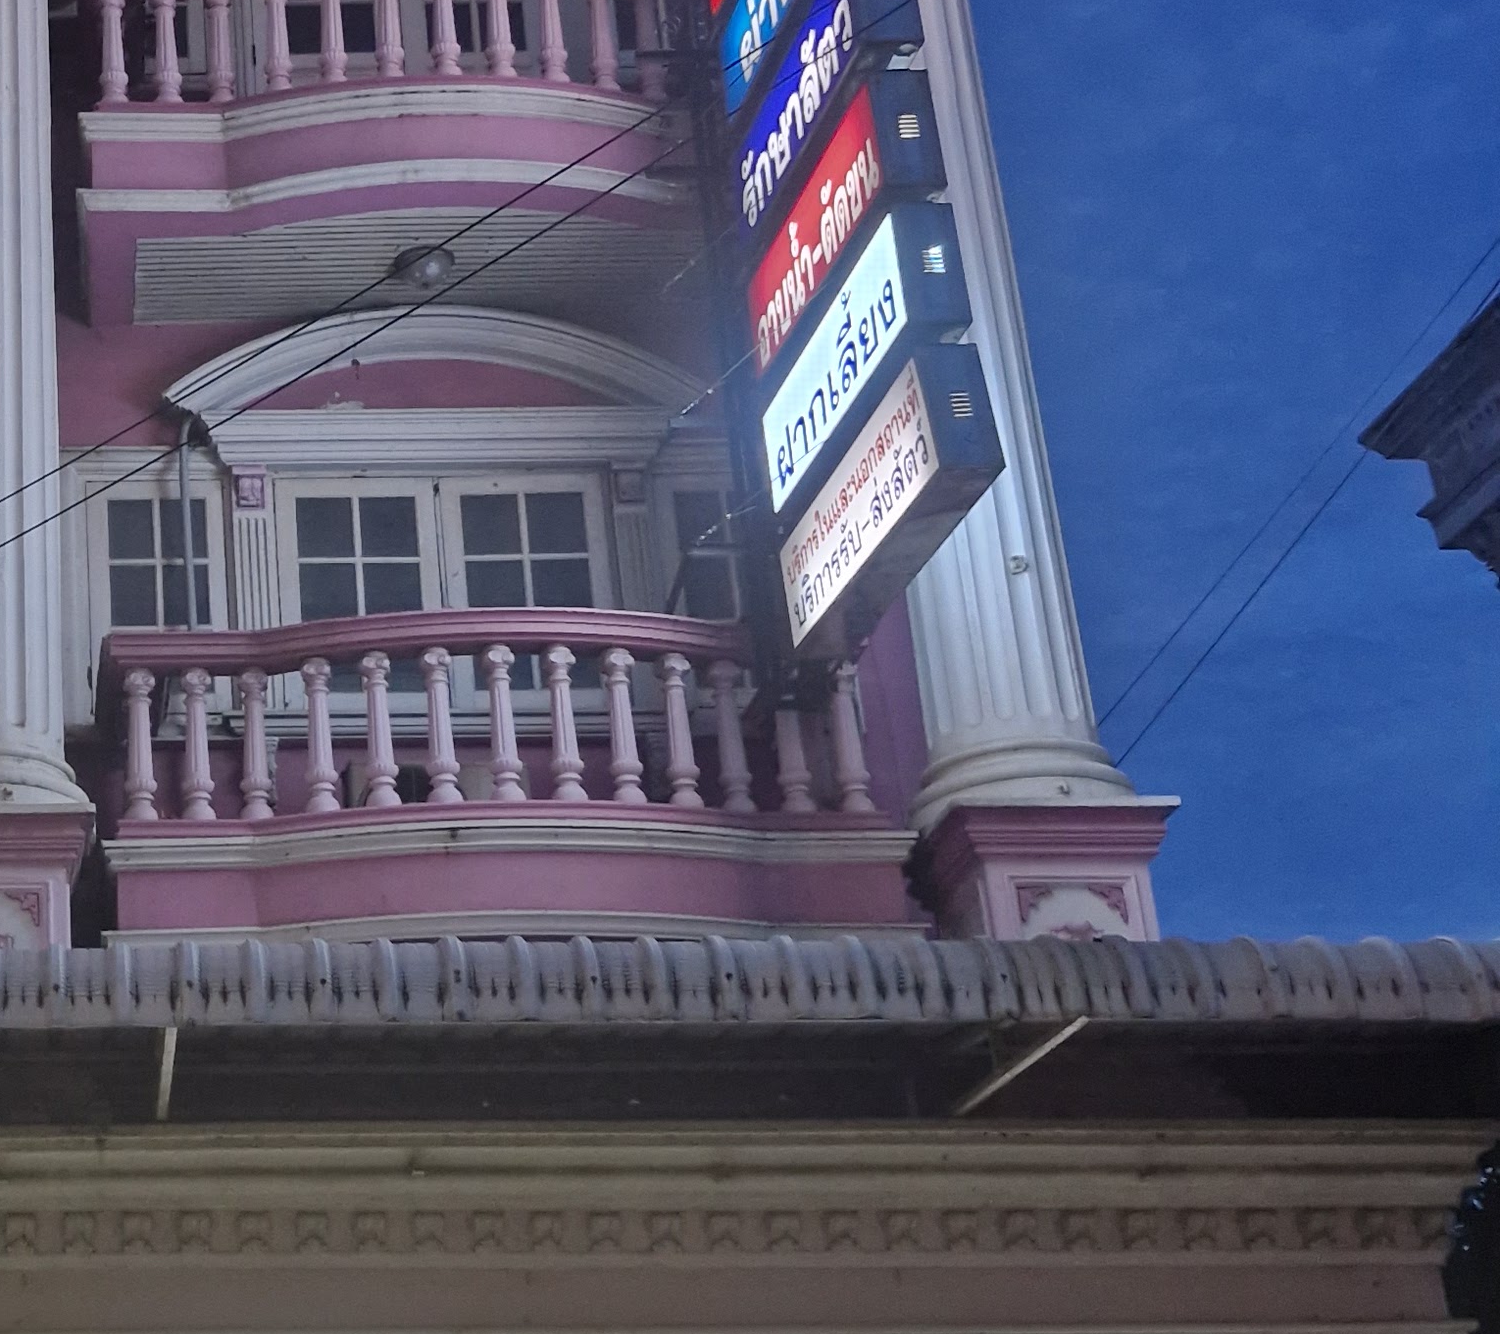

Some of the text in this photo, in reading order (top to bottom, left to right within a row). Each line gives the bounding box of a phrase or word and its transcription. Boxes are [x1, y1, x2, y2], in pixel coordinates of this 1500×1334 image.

[759, 136, 880, 368] อาบน้ำ-ตัดขน
[776, 276, 899, 481] ฝากเลี้ยง
[786, 366, 921, 586] บริการในและนอกสถานที่
[794, 424, 930, 627] บริการรับ-ส่งสัตว์
